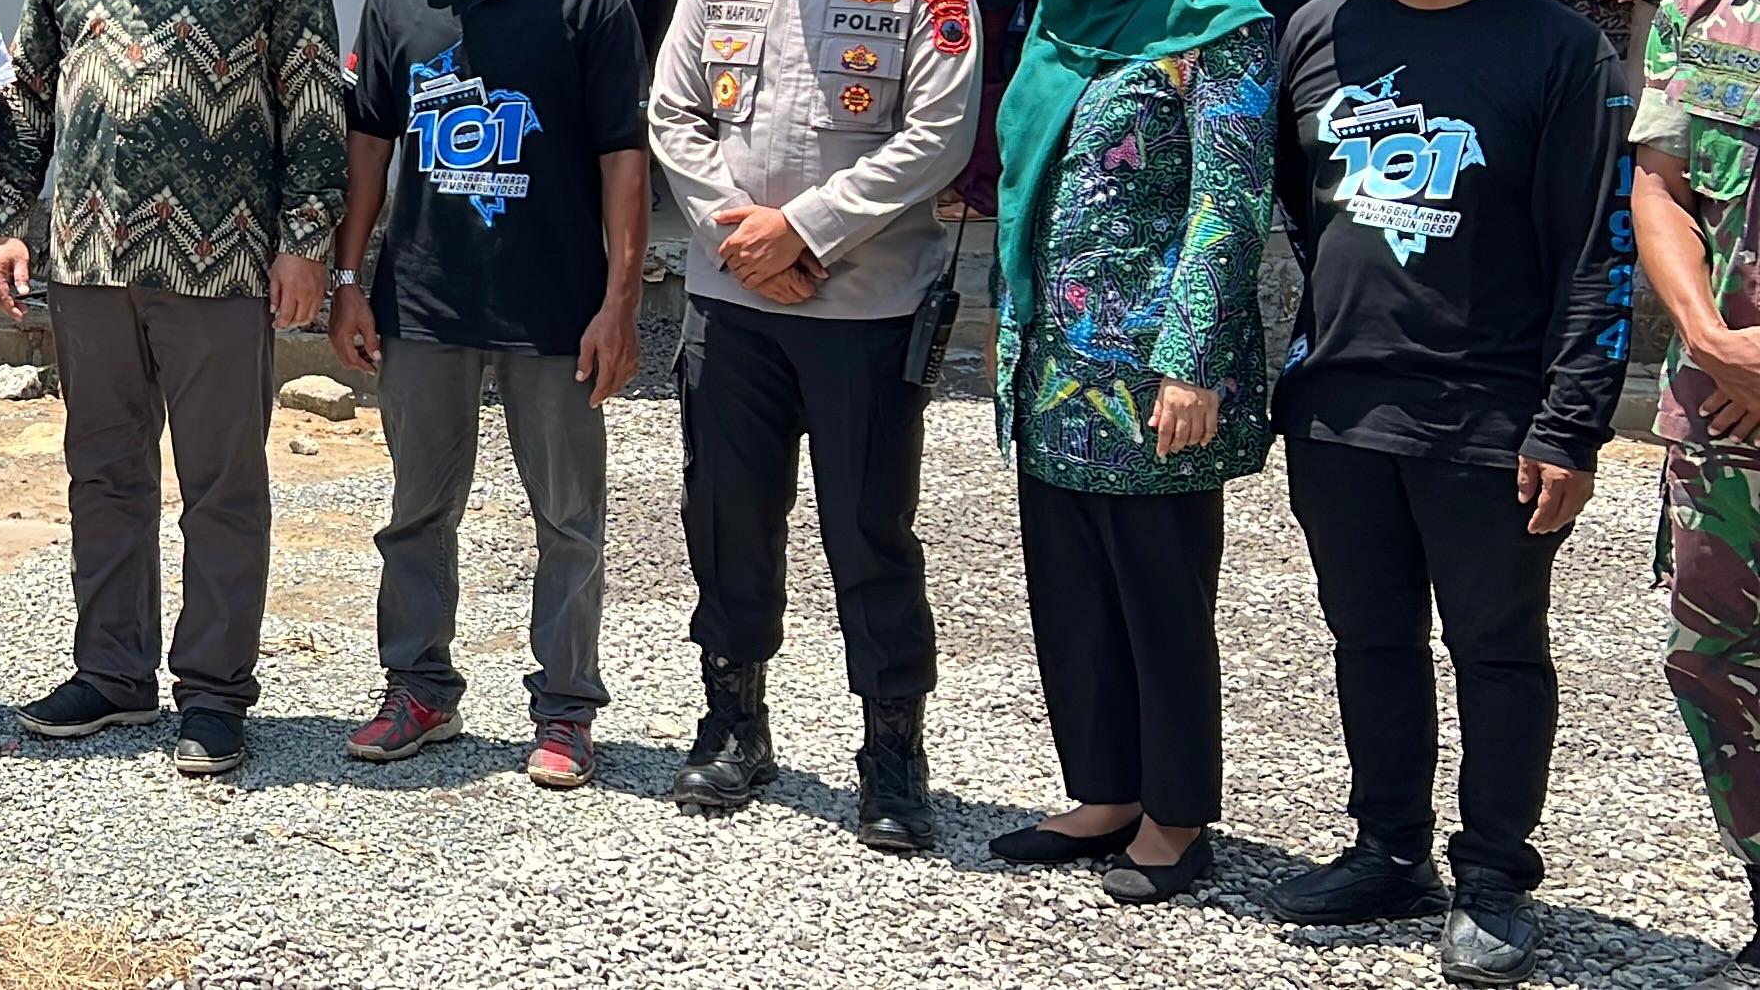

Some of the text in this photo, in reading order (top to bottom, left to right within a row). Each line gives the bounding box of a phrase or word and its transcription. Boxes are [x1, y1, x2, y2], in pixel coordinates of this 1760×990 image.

[833, 13, 900, 33] POLRI
[407, 102, 527, 172] 101
[1329, 131, 1469, 201] 101
[1419, 210, 1457, 224] KARSA
[1421, 221, 1452, 234] DESA
